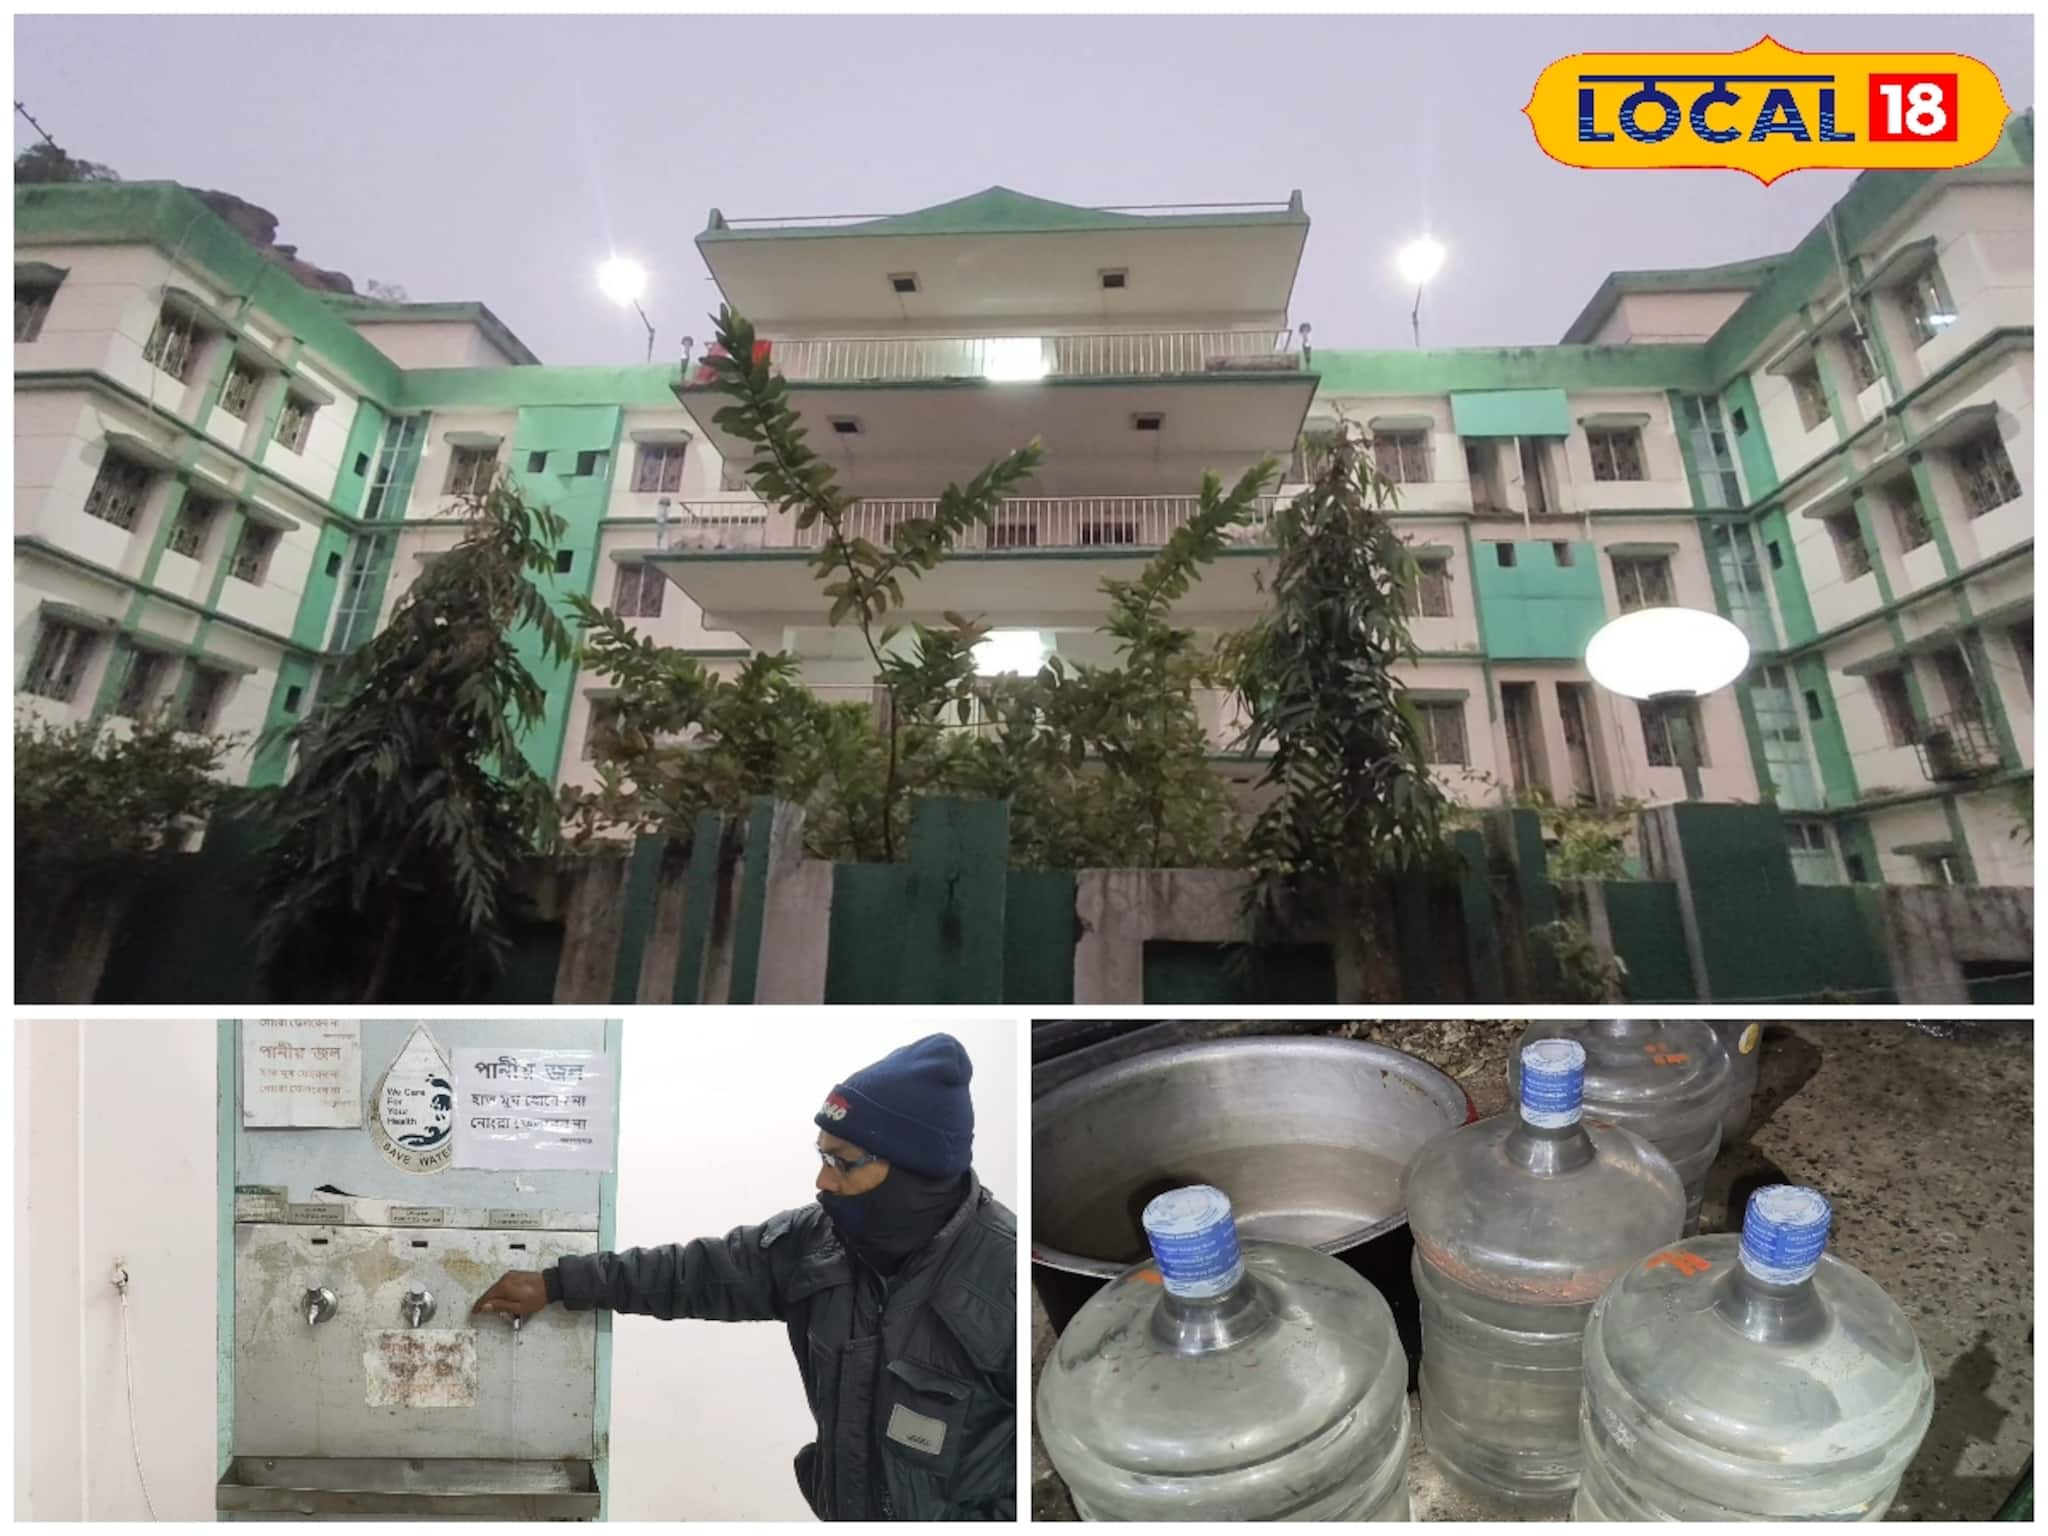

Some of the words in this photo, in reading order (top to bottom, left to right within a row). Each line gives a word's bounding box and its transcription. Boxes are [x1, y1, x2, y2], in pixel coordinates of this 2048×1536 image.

[475, 1056, 535, 1080] পানীয়
[544, 1064, 584, 1080] জল
[419, 1148, 451, 1166] WATE
